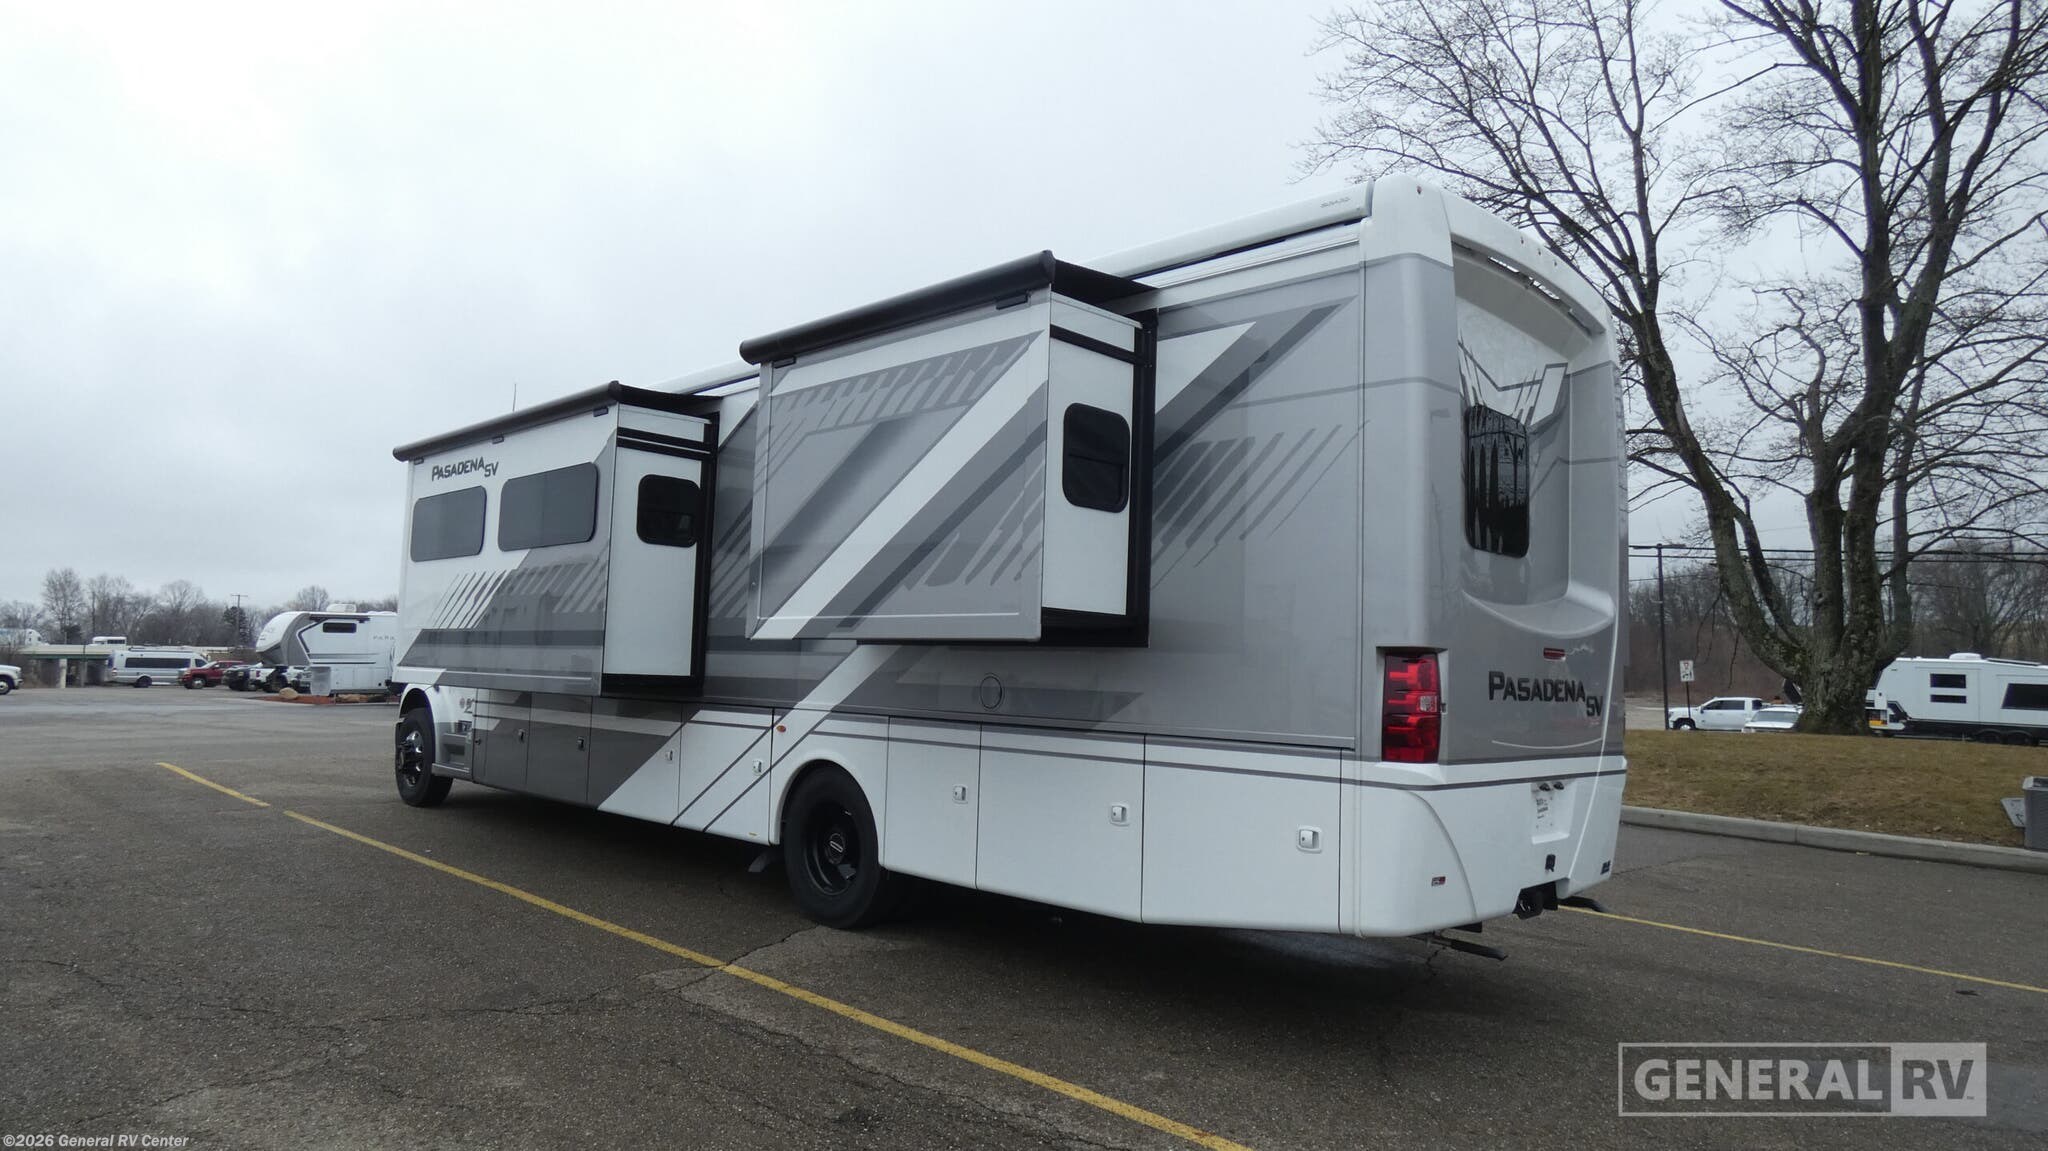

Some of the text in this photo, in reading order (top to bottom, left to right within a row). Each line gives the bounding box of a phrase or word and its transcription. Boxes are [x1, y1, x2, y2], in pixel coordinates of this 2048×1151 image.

[432, 456, 499, 482] PASADENA SV
[1488, 671, 1604, 717] PASADENA SV
